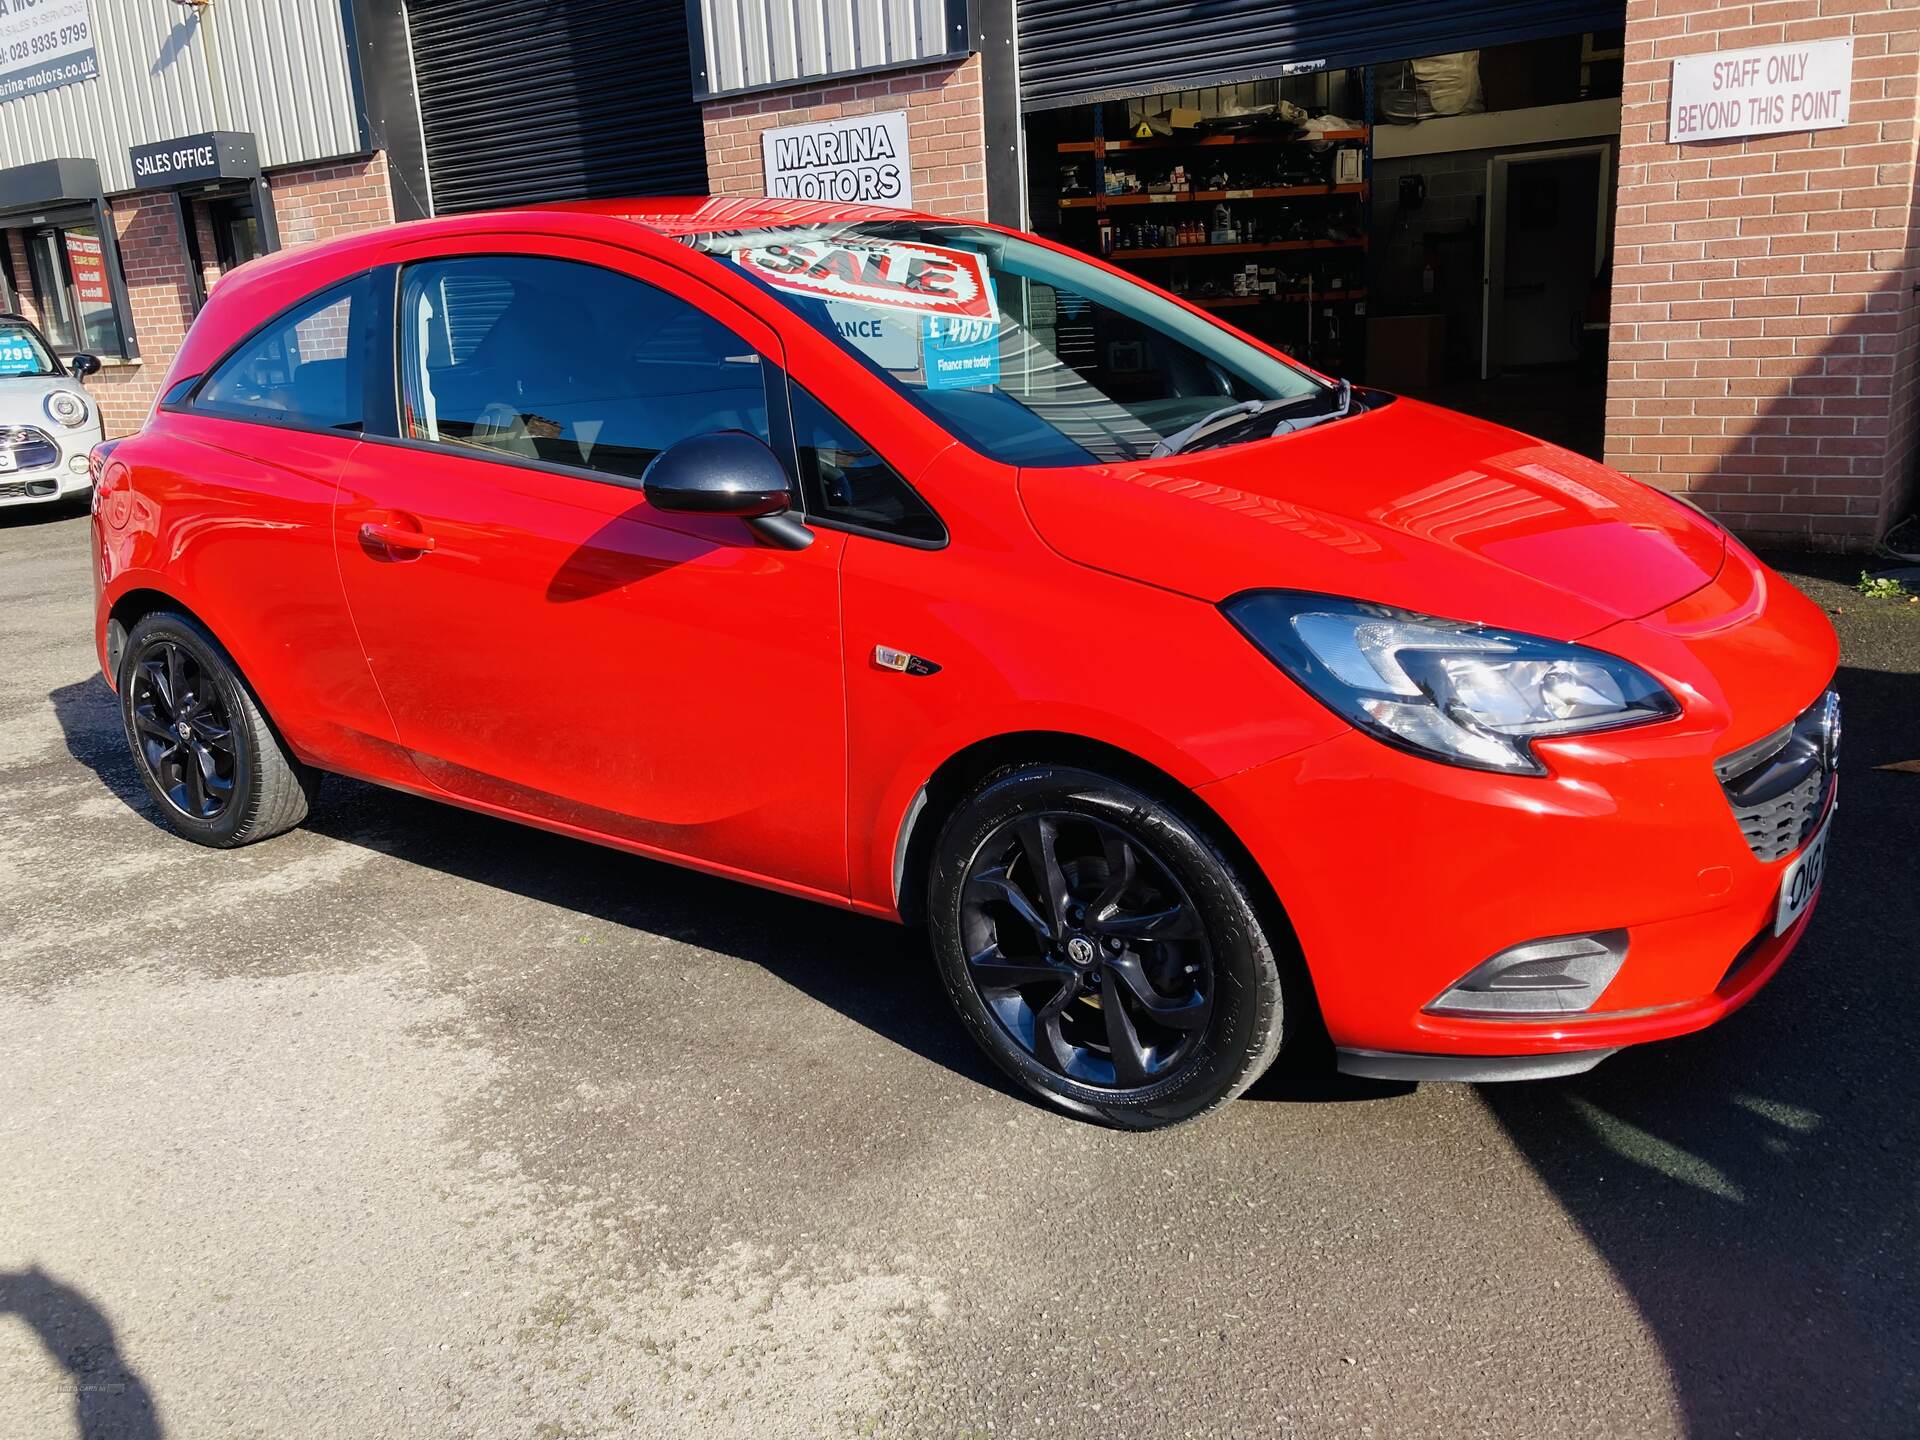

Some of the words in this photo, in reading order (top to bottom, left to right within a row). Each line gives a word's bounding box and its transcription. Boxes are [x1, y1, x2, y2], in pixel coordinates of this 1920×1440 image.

[10, 41, 29, 61] 028
[31, 32, 58, 54] 9335
[60, 22, 87, 46] 9799
[1712, 58, 1761, 91] STAFF
[1767, 52, 1809, 85] ONLY
[1677, 99, 1742, 133] BEYOND
[1748, 94, 1785, 126] THIS
[1791, 90, 1842, 122] POINT
[135, 153, 171, 176] SALES
[172, 146, 215, 170] OFFICE
[776, 125, 895, 171] MARINA
[775, 164, 901, 202] MOTORS
[756, 244, 960, 299] SALE
[0, 347, 33, 361] 295
[937, 358, 962, 372] Finance
[963, 361, 973, 369] me
[973, 355, 991, 370] today!
